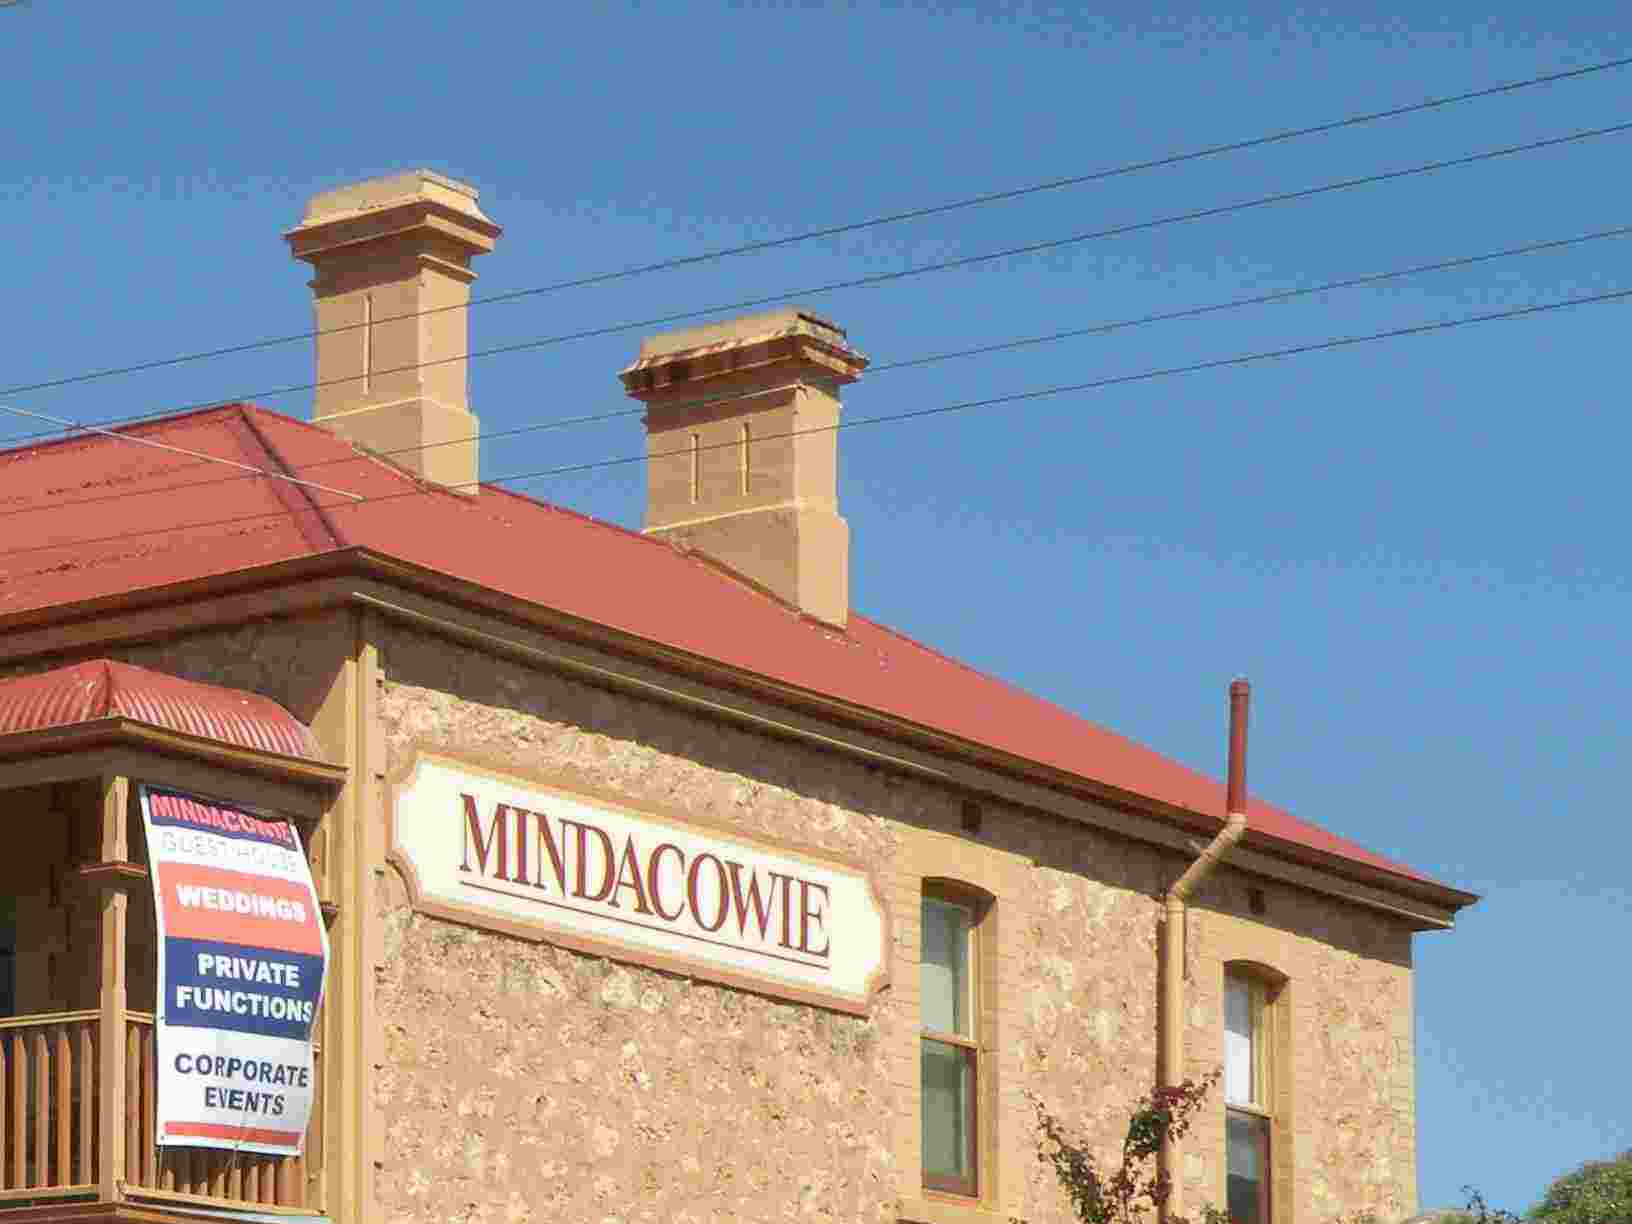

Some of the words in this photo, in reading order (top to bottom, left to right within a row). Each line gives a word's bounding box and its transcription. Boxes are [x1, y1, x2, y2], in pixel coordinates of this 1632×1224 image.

[459, 792, 832, 959] MINDACOWIE
[175, 882, 306, 922] WEDDINGS
[197, 952, 300, 988] PRIVATE
[175, 985, 313, 1024] FUNCTIONS
[173, 1052, 309, 1089] CORPORATE
[204, 1086, 286, 1116] EVENTS
